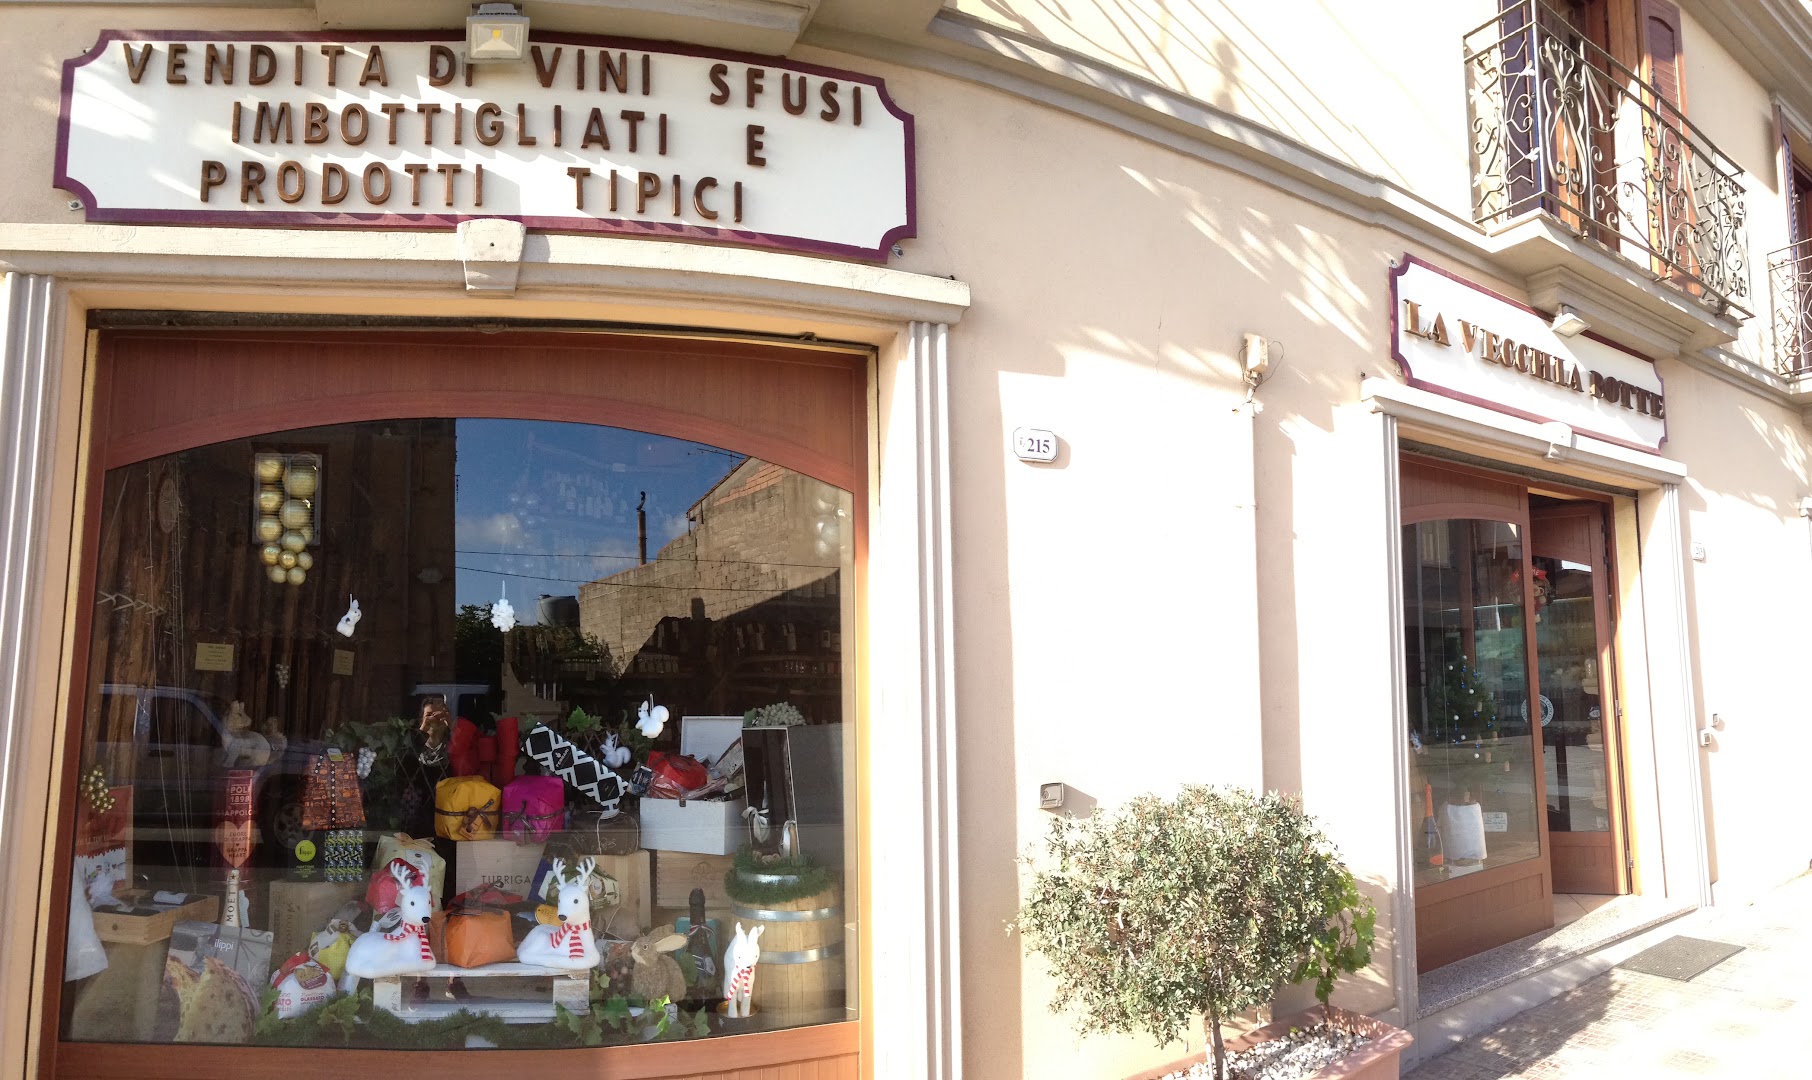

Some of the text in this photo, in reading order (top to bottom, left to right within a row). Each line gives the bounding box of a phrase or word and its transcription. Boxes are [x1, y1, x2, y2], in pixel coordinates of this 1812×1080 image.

[122, 42, 389, 88] VENDITA
[530, 45, 651, 97] VINI
[709, 63, 863, 127] SFUSI
[231, 100, 768, 168] IMBOTTIGLIATI E
[199, 159, 743, 223] PRODOTTI TIPICI
[1402, 297, 1665, 420] LA VECCHIA BOTTE
[1027, 437, 1051, 454] 215
[481, 875, 531, 885] TURRIGA
